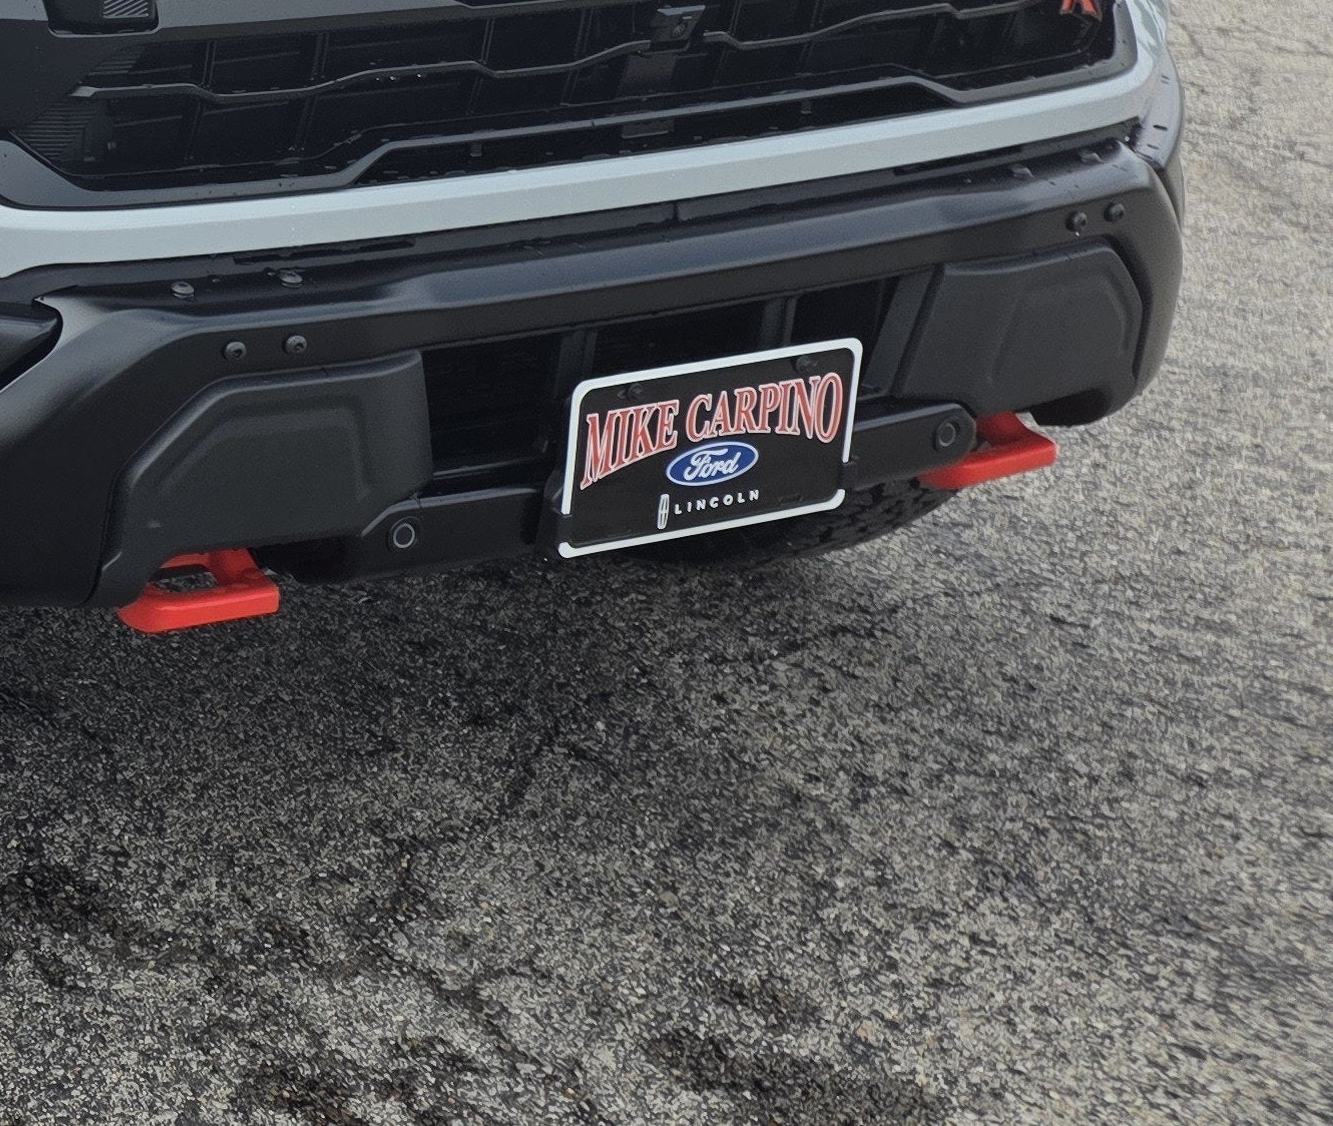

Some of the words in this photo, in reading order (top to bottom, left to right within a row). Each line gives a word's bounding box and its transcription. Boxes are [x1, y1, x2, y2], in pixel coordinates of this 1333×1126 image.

[580, 399, 680, 490] MIKE
[685, 372, 843, 444] CARPINO
[683, 448, 742, 481] Ford
[675, 489, 760, 515] LINCOLN
